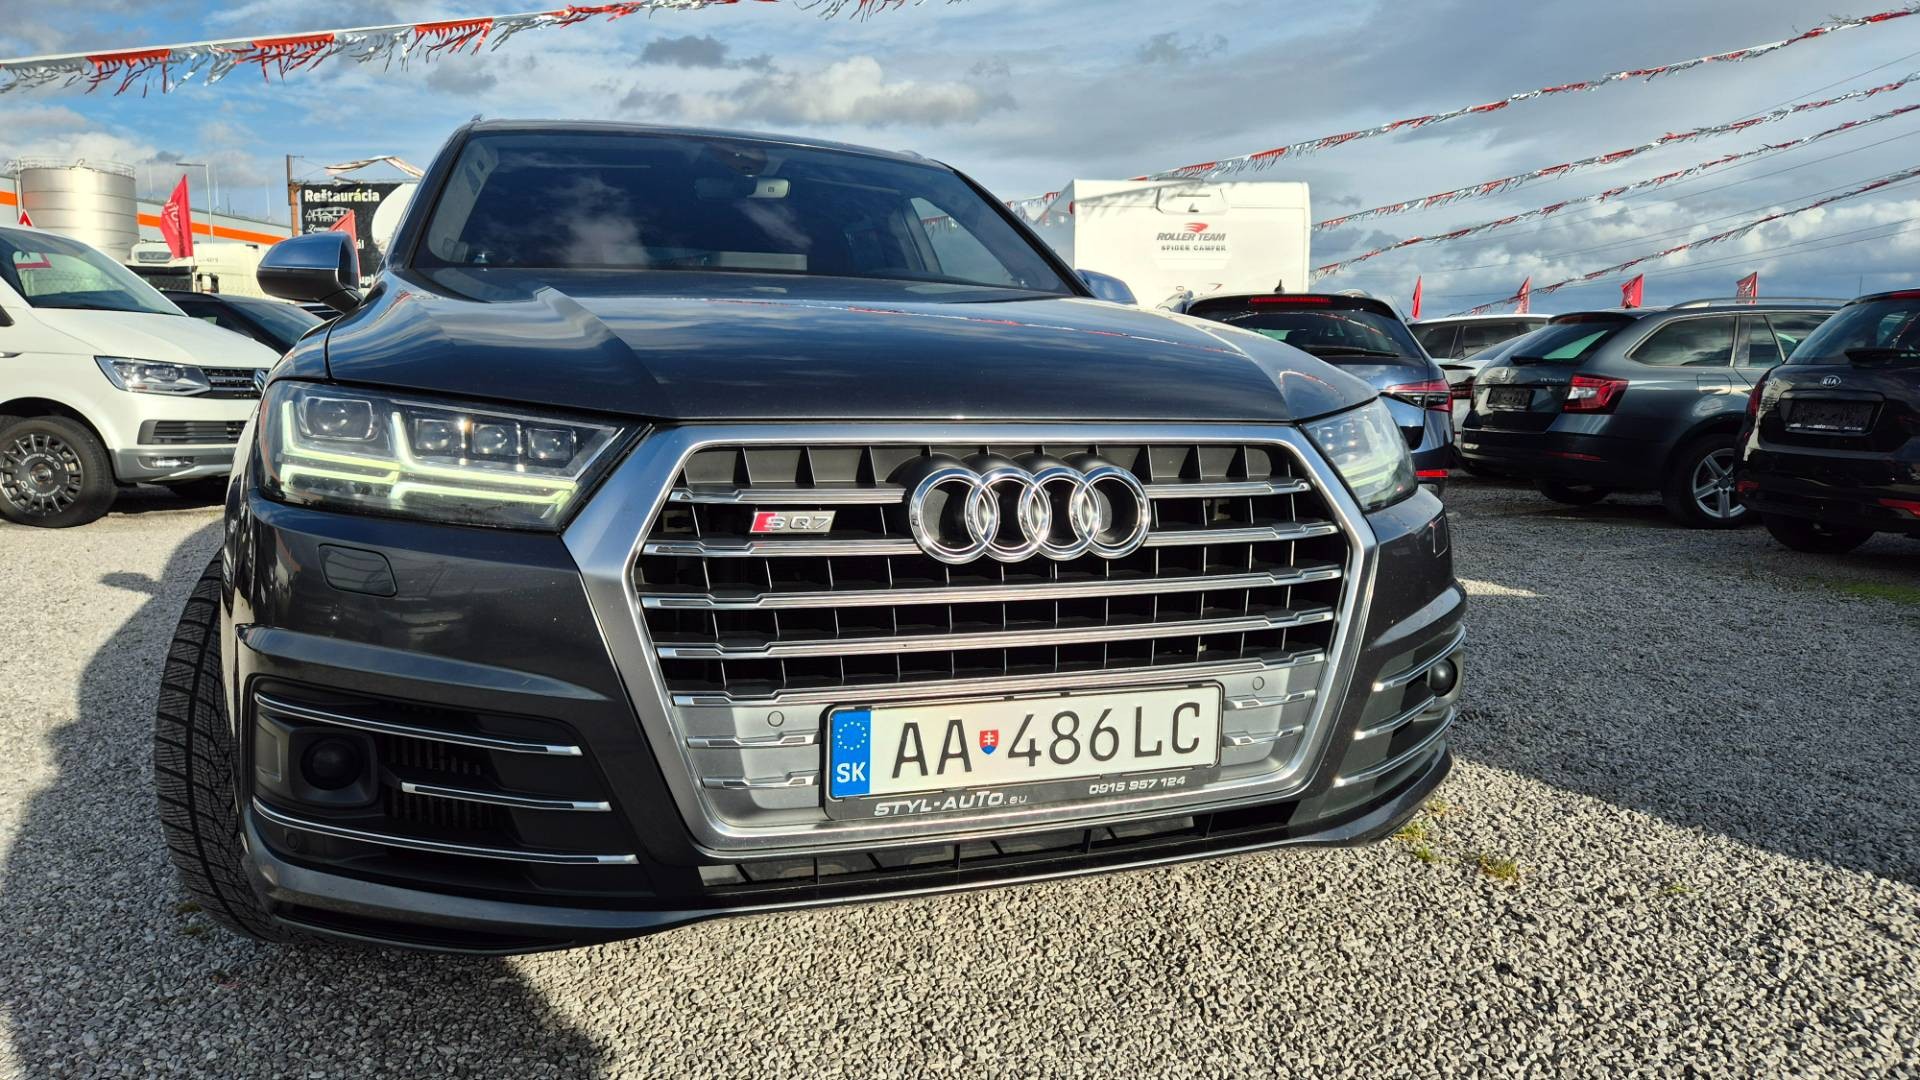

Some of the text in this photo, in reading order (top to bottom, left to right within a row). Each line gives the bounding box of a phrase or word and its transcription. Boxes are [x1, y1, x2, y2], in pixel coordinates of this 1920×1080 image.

[304, 188, 380, 202] Reštaurácia
[1156, 232, 1226, 241] ROLLER TEAM
[763, 515, 832, 530] SQ7
[891, 701, 1201, 780] AA 486LC
[836, 761, 866, 784] SK
[1088, 775, 1186, 795] 0915 957 124
